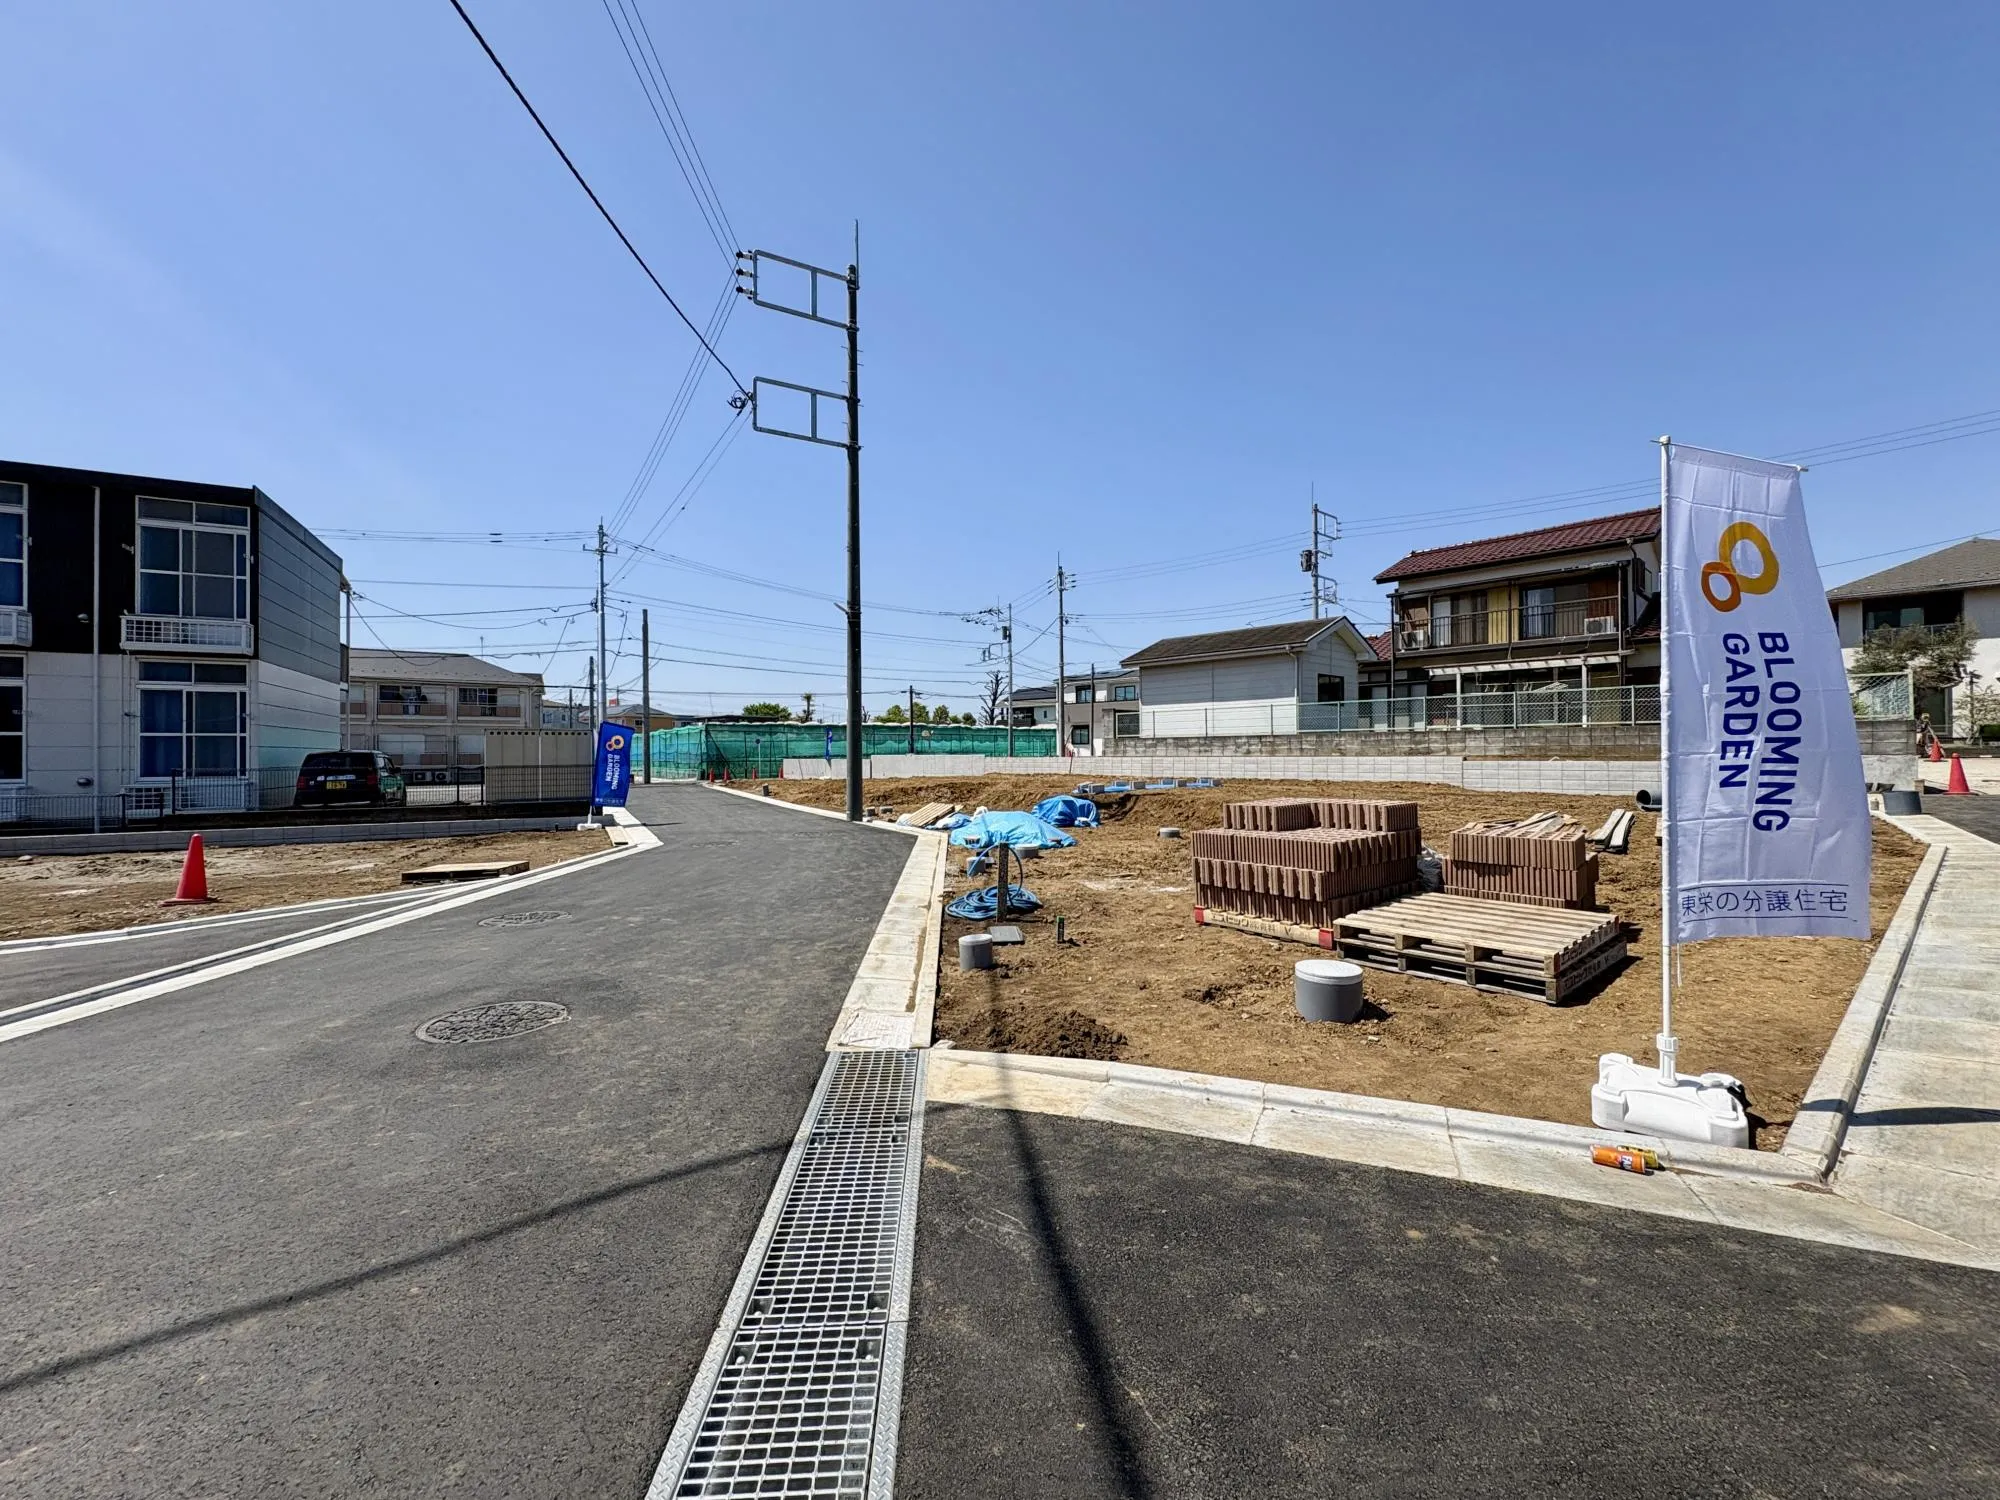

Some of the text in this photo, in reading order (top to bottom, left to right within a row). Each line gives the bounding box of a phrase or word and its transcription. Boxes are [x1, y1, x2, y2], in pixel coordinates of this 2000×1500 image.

[1718, 633, 1760, 788] GARDEN
[1752, 632, 1802, 831] BLOOMING
[605, 753, 613, 782] GARDEN
[611, 754, 621, 790] BLOOMING
[1681, 889, 1847, 916] 東栄の分譲住宅
